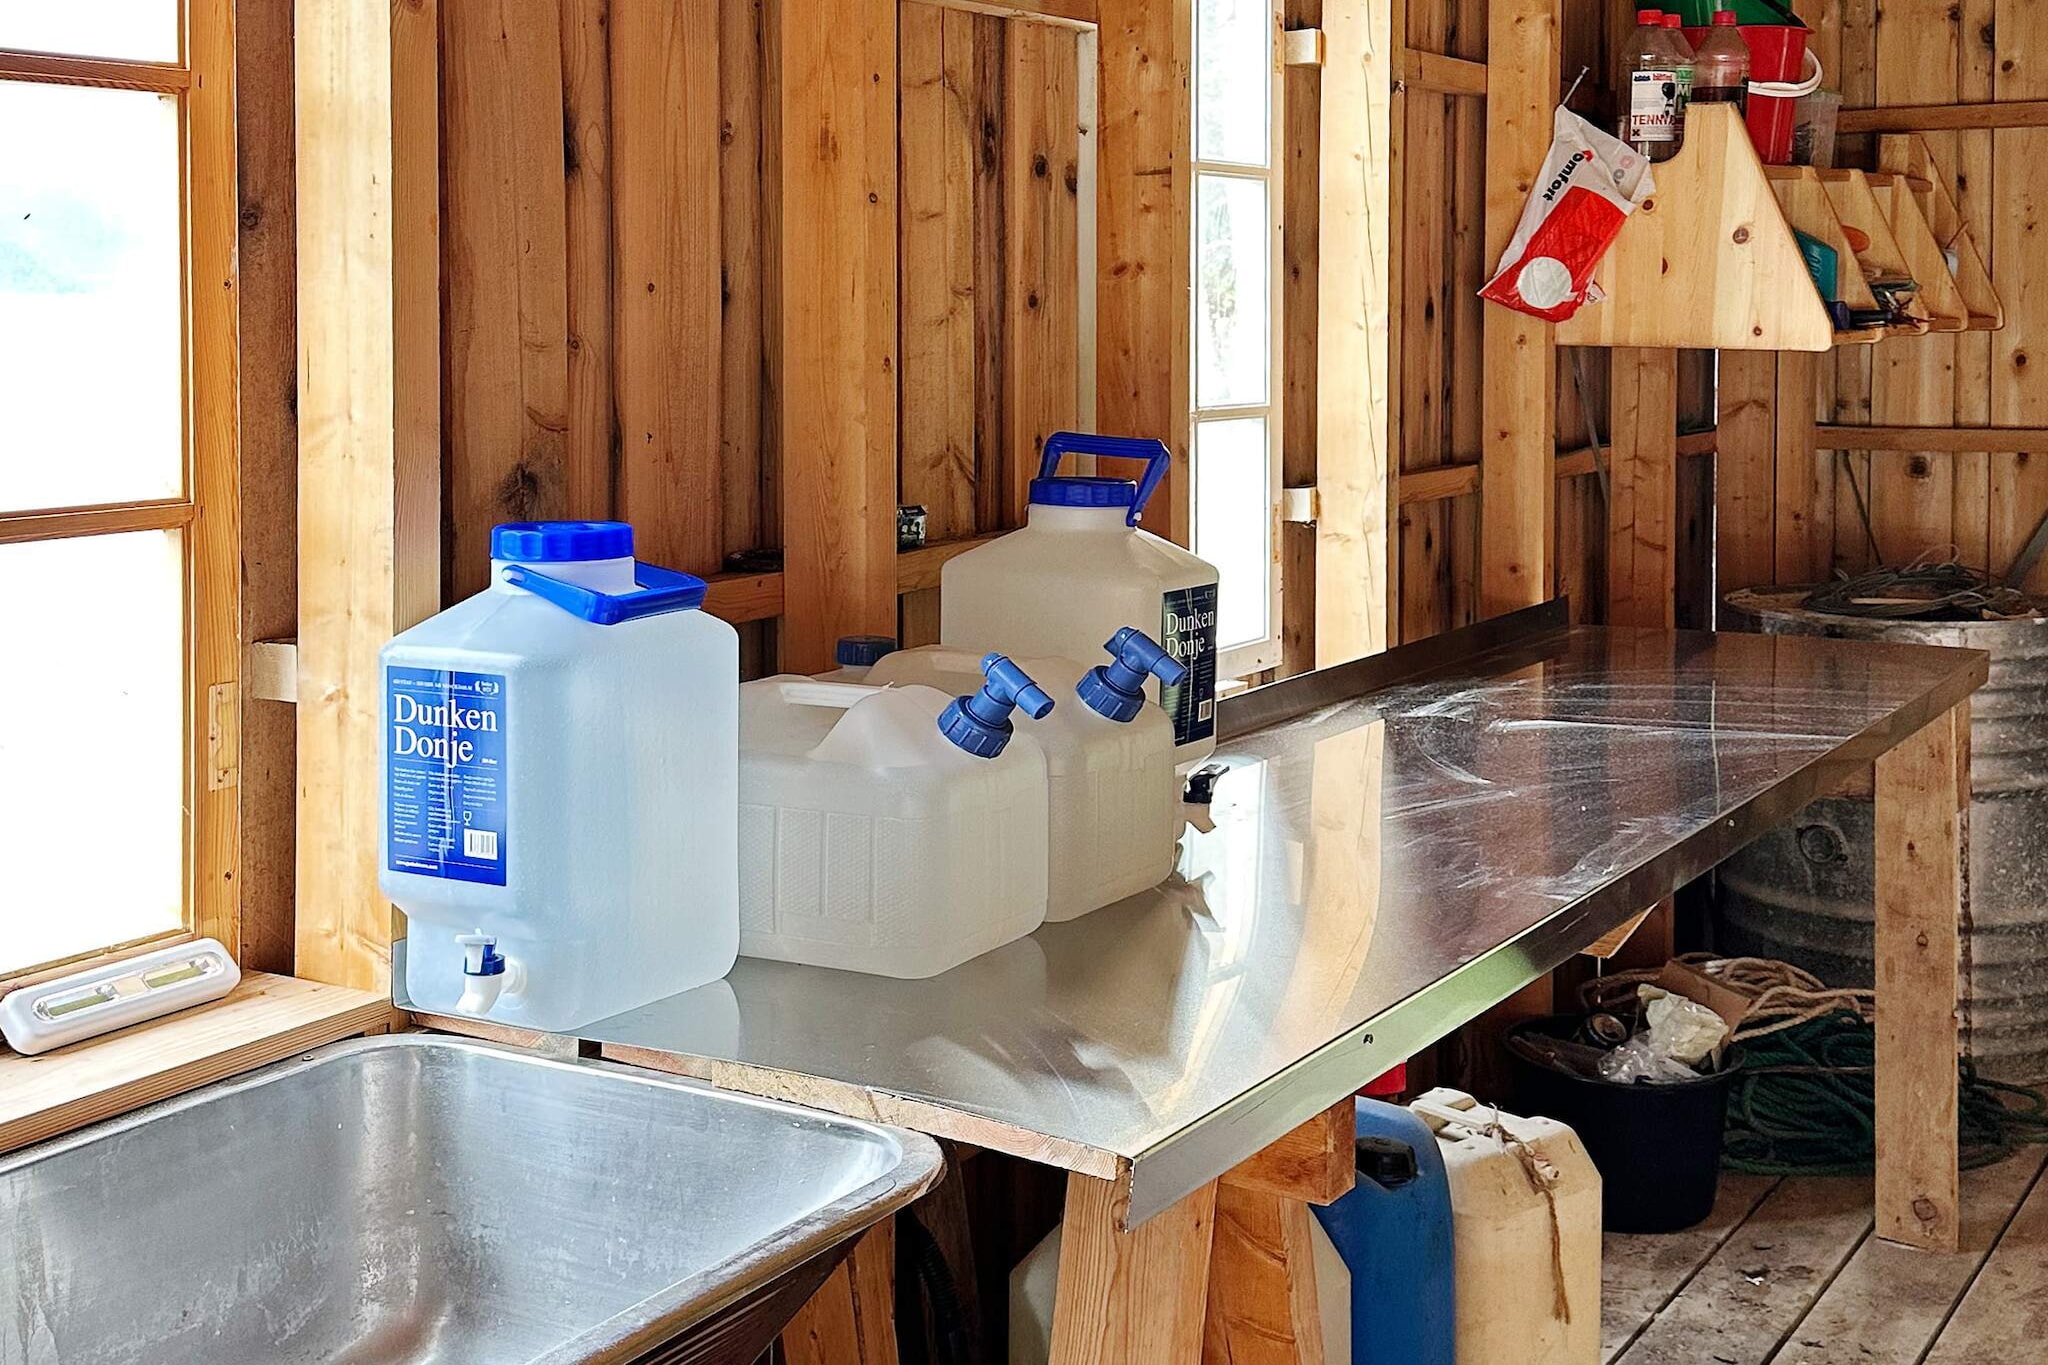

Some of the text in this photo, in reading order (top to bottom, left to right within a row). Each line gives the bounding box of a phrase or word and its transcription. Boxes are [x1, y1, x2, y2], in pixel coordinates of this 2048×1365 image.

[1166, 608, 1215, 636] Dunken
[1166, 634, 1206, 660] Donje
[393, 693, 498, 732] Dunken
[393, 726, 474, 768] Donje
